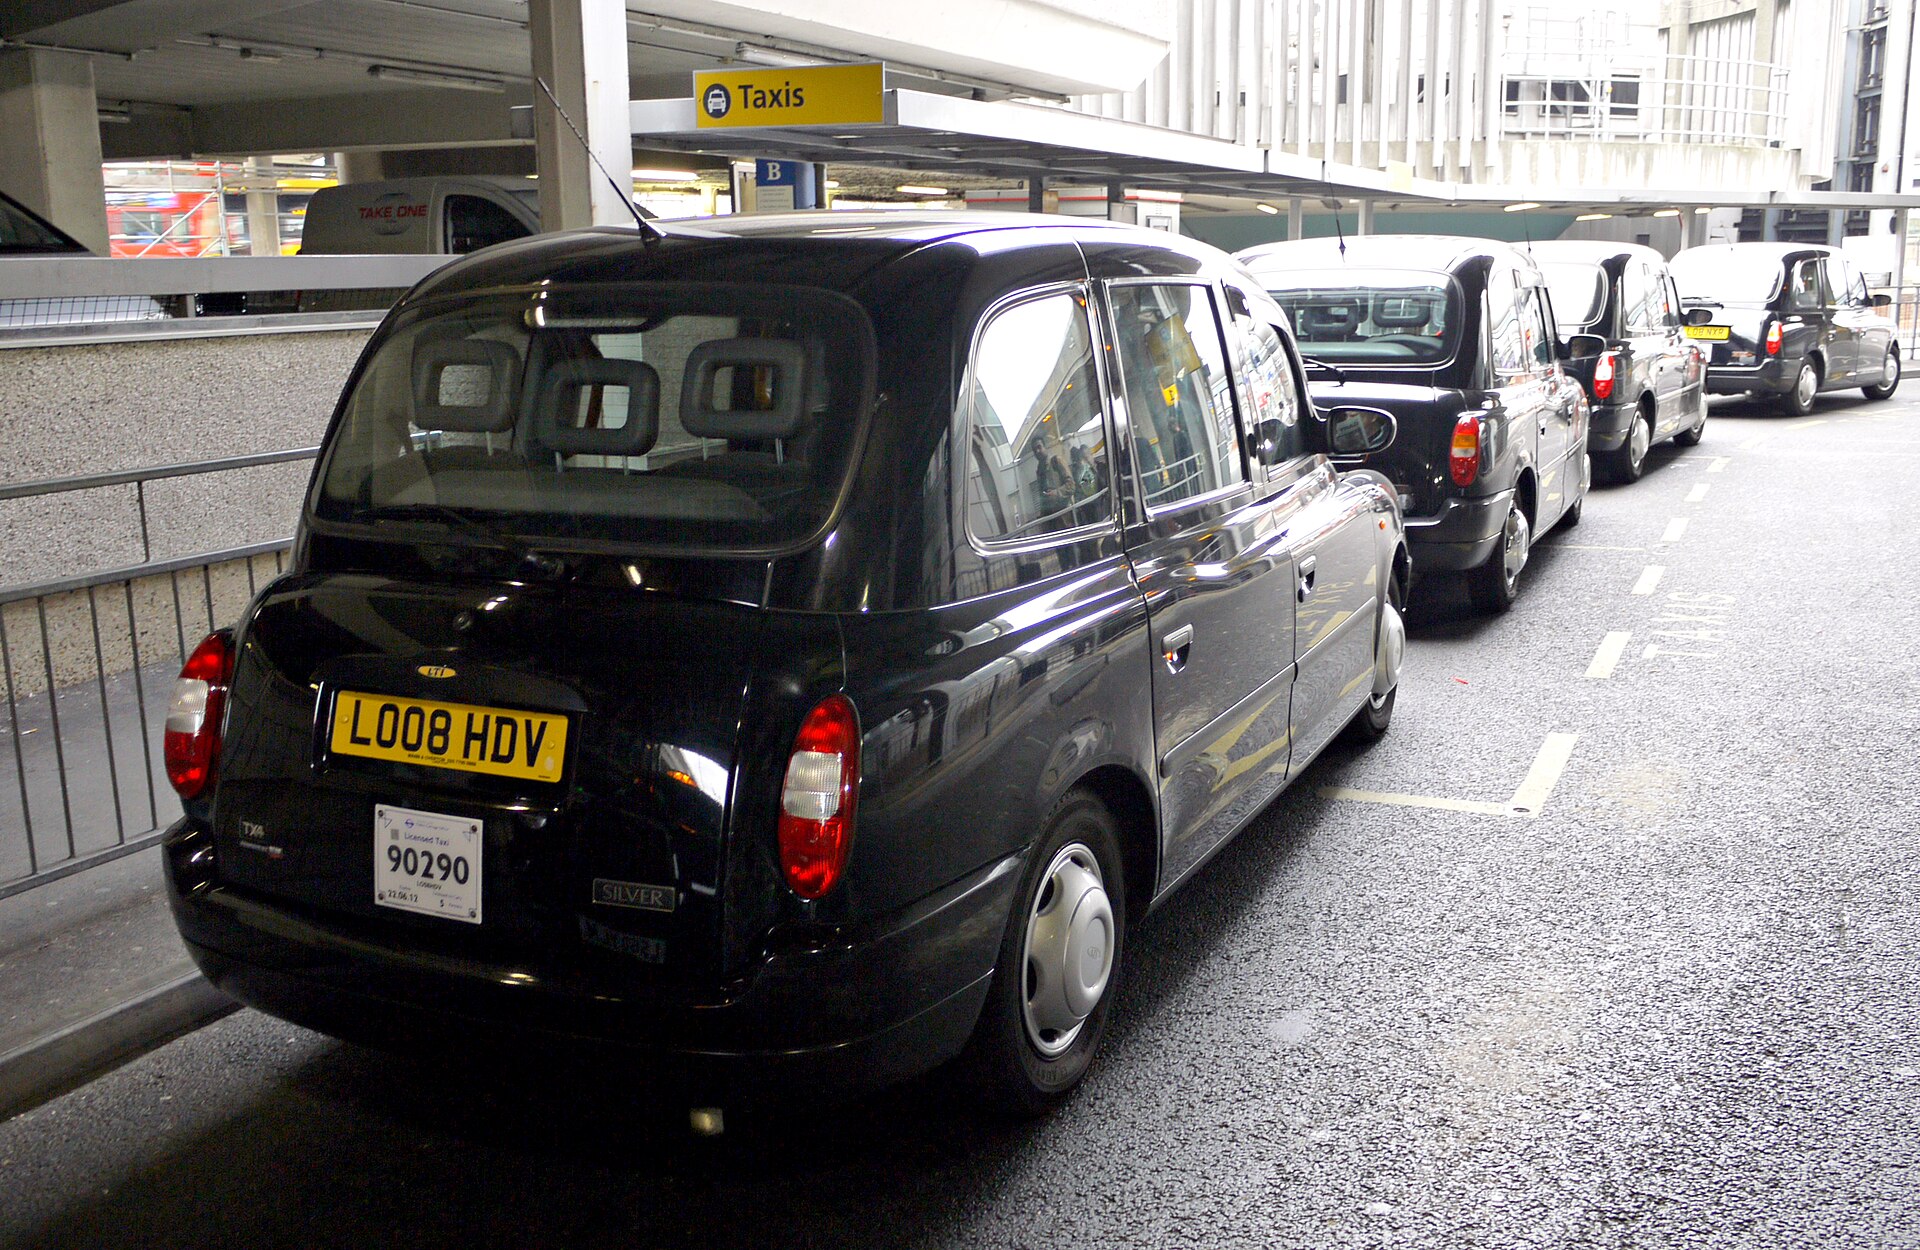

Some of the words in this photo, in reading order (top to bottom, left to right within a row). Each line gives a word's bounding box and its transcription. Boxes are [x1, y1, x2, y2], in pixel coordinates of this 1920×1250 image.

[738, 81, 805, 110] Taxis
[767, 162, 782, 181] B
[359, 206, 393, 219] TAKE
[397, 205, 428, 218] ONE
[350, 699, 452, 756] LO08
[463, 712, 549, 768] HDV
[242, 820, 265, 839] TX4
[387, 844, 470, 885] 90290
[603, 883, 664, 906] SILVER
